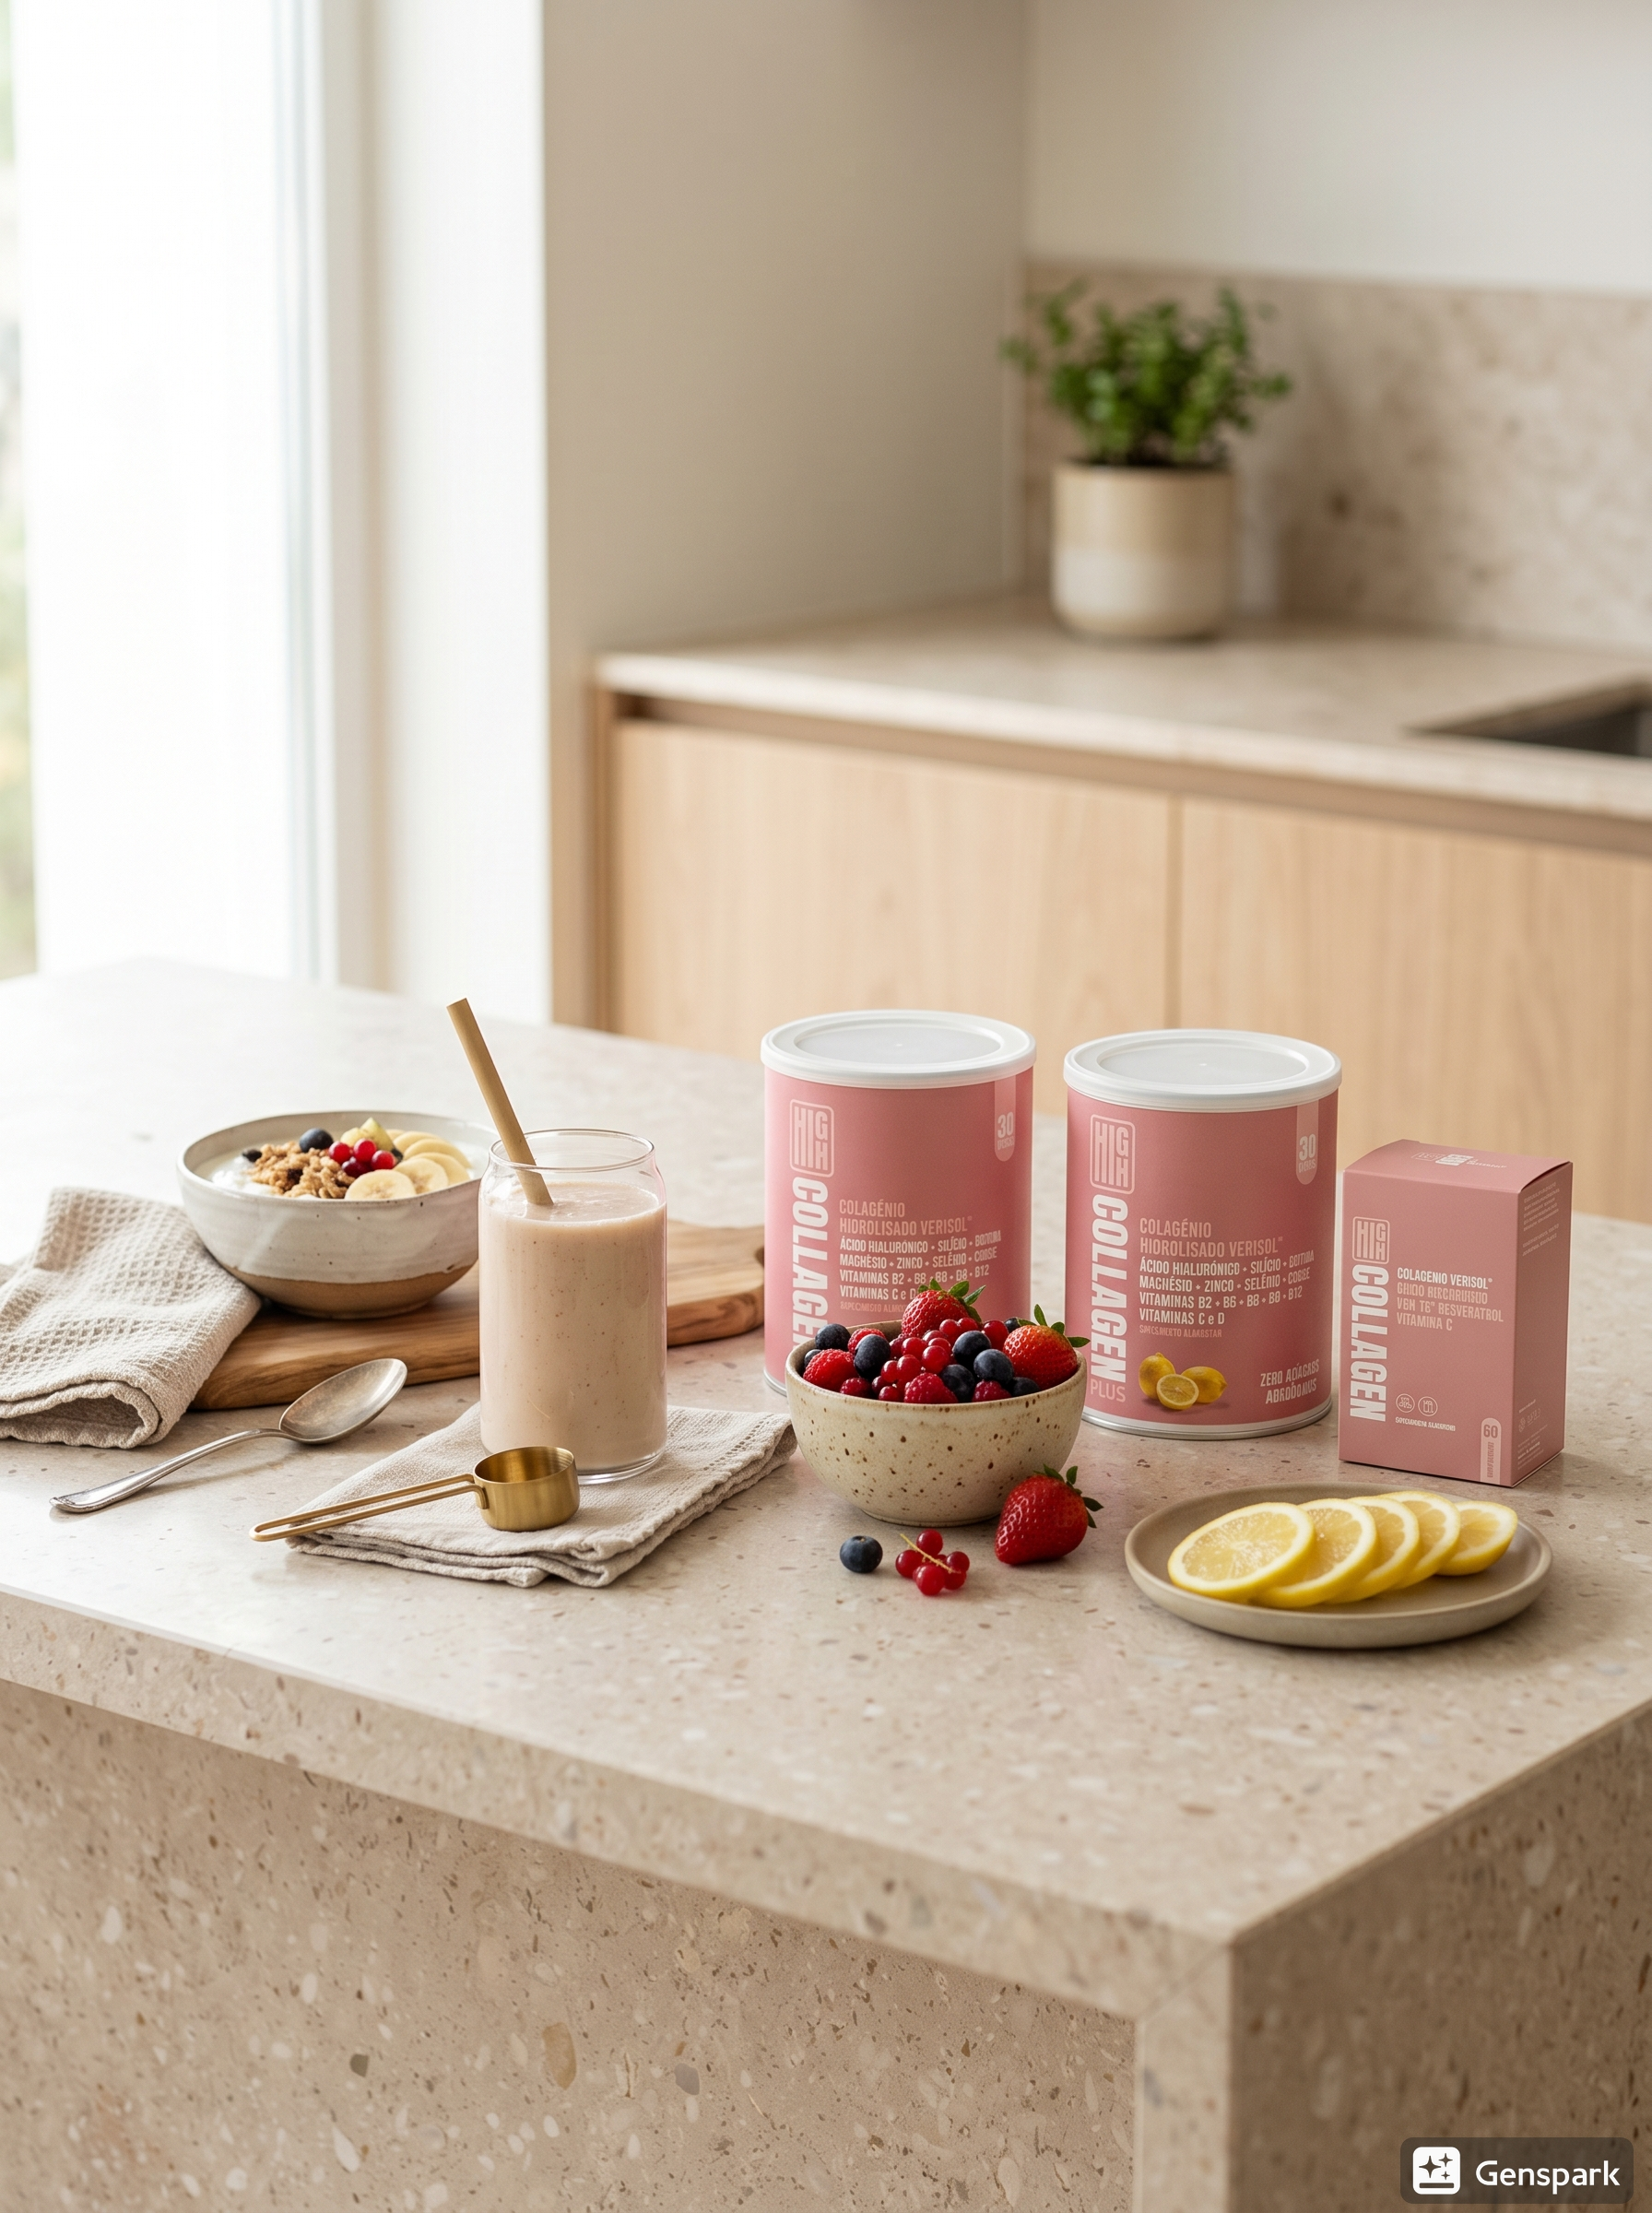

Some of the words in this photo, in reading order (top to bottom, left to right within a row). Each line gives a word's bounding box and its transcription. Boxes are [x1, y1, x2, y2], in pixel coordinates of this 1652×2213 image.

[997, 1111, 1014, 1139] 30
[1299, 1133, 1316, 1161] 30
[839, 1199, 905, 1218] COLAGÉNIO
[840, 1218, 917, 1237] HIDROLISADO
[1139, 1217, 1211, 1238] COLAGÉNIO
[792, 1177, 829, 1349] COLLAGE
[1139, 1256, 1169, 1274] ÁCIDO
[1250, 1257, 1280, 1274] SILÍCIO
[839, 1269, 889, 1284] VITAMINAS
[892, 1272, 904, 1285] B2
[975, 1264, 990, 1278] B12
[839, 1284, 889, 1300] VITAMINAS
[892, 1288, 899, 1300] C
[901, 1290, 906, 1300] e
[1090, 1194, 1128, 1383] COLLAGEN
[1204, 1279, 1234, 1293] ZINCO
[1139, 1291, 1194, 1308] VITAMINAS
[1198, 1296, 1212, 1308] B2
[1223, 1296, 1236, 1308] B6
[1246, 1294, 1259, 1307] B8
[1288, 1285, 1303, 1300] B12
[1139, 1308, 1194, 1325] VITAMINAS
[1198, 1312, 1205, 1325] C
[1209, 1315, 1214, 1325] e
[1218, 1312, 1225, 1325] D
[1397, 1311, 1443, 1330] VITAMINA
[1446, 1318, 1453, 1331] C
[1350, 1264, 1389, 1422] COLLAGEN
[1260, 1370, 1283, 1387] ZERO
[1090, 1378, 1126, 1402] PLUS
[1483, 1424, 1499, 1438] 60
